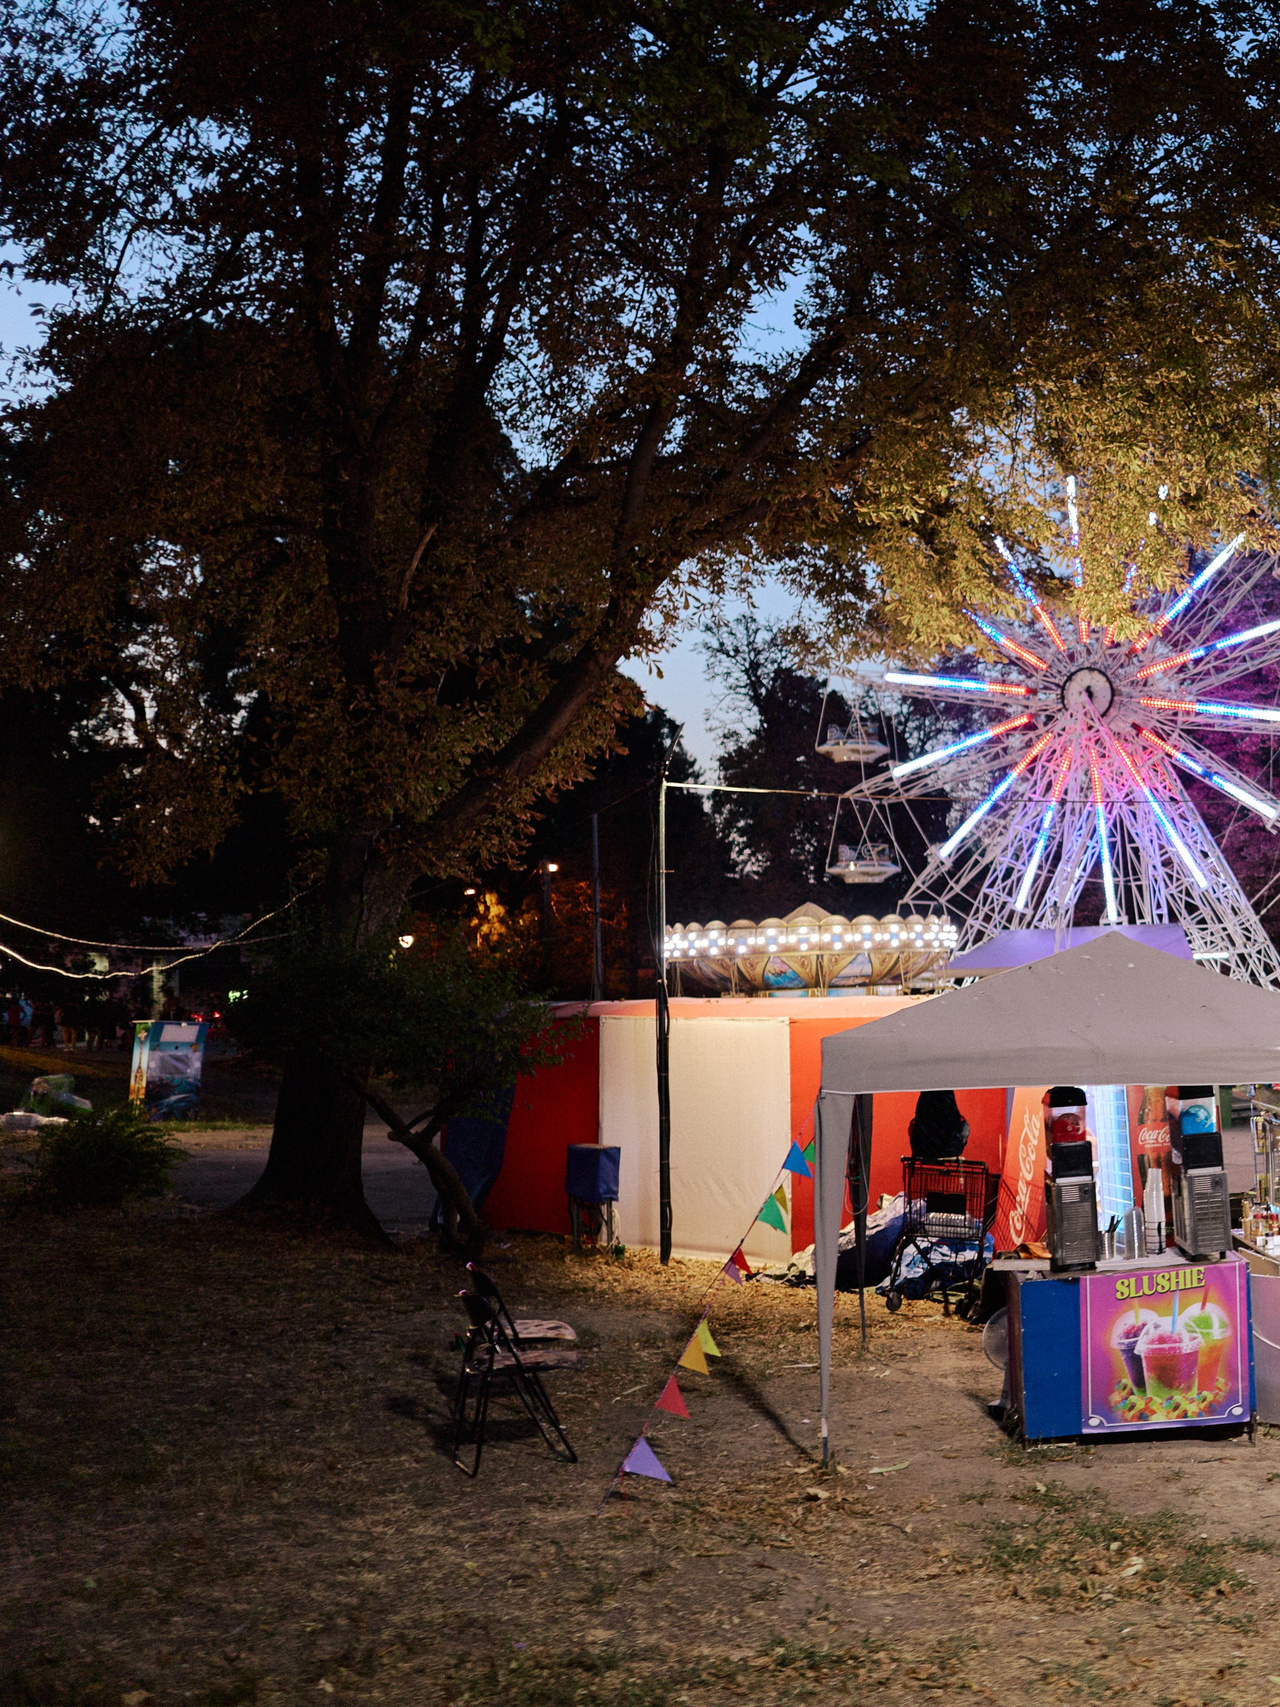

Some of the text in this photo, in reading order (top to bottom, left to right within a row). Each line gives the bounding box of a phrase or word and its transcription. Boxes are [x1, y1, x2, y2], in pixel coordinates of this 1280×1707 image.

[1138, 1125, 1171, 1145] Coca-Co
[1009, 1106, 1042, 1245] Coca-Cola
[1115, 1267, 1205, 1300] SLUSHIE
